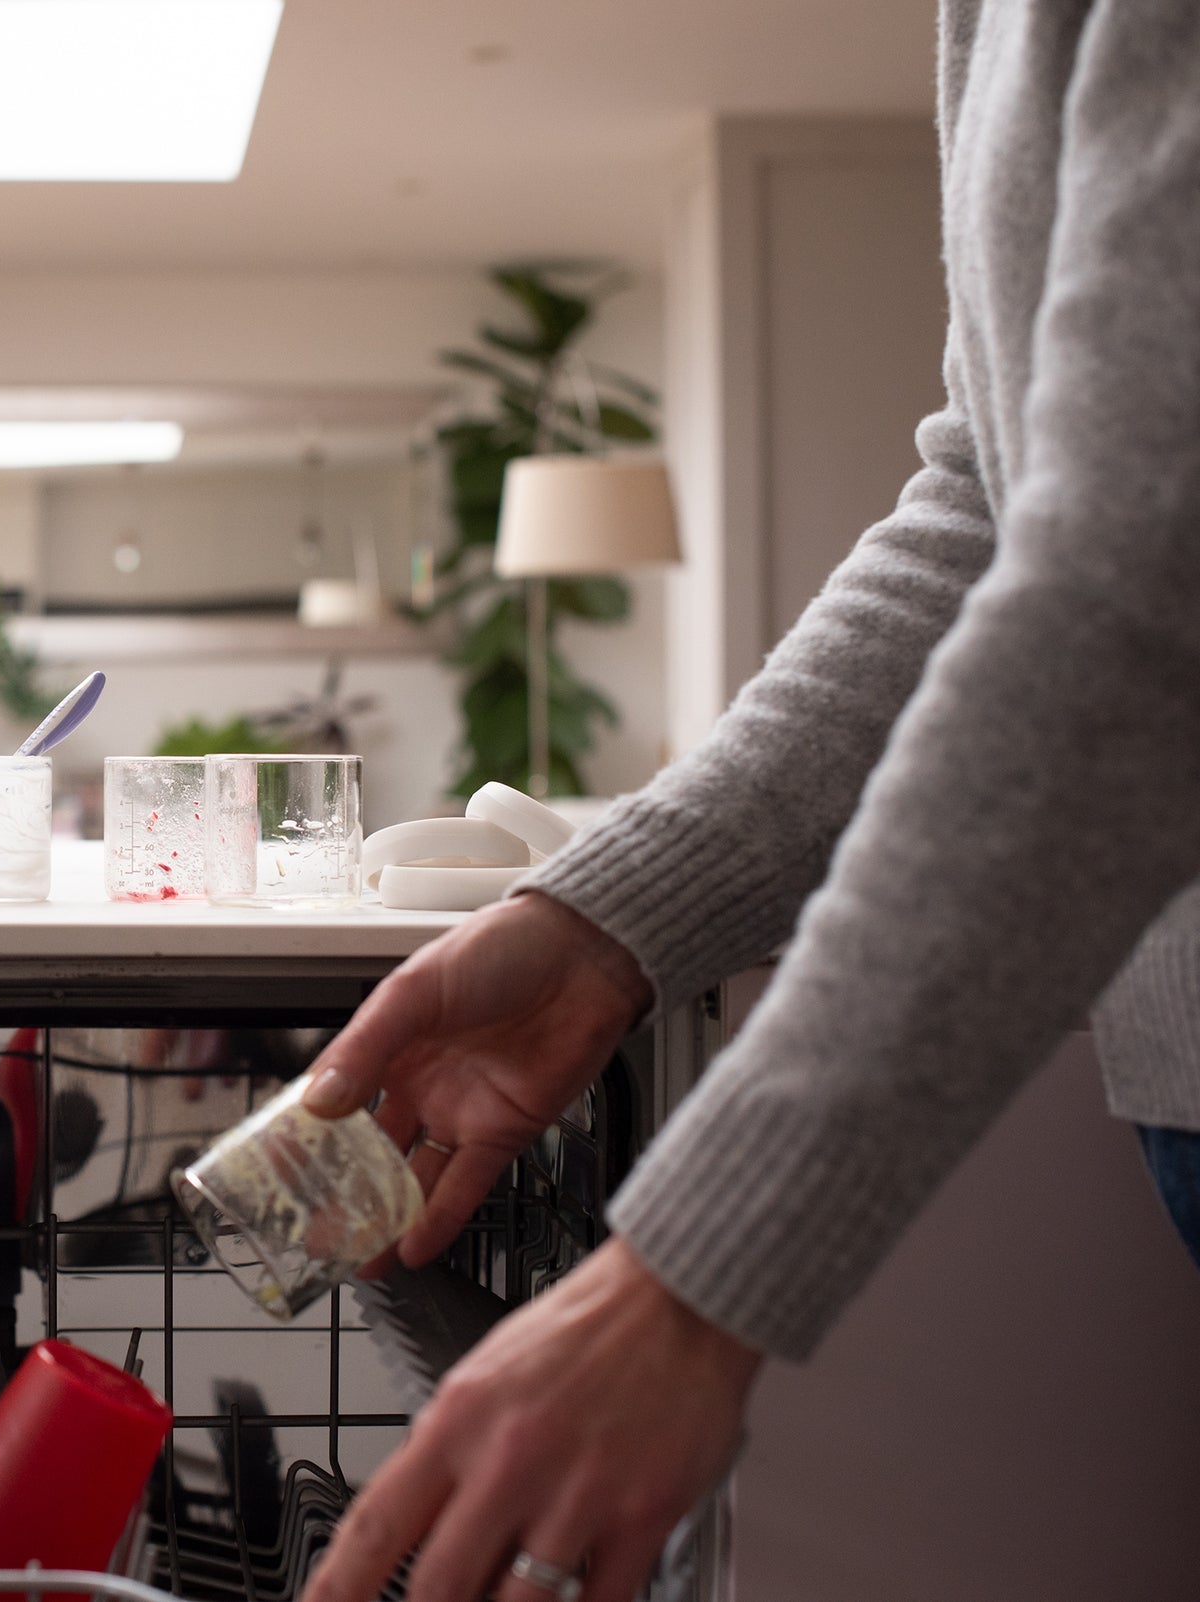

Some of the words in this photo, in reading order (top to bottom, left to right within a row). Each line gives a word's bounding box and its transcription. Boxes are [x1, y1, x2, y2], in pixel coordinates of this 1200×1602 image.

[144, 843, 155, 852] 60
[144, 868, 155, 877] 30
[144, 880, 155, 888] ml
